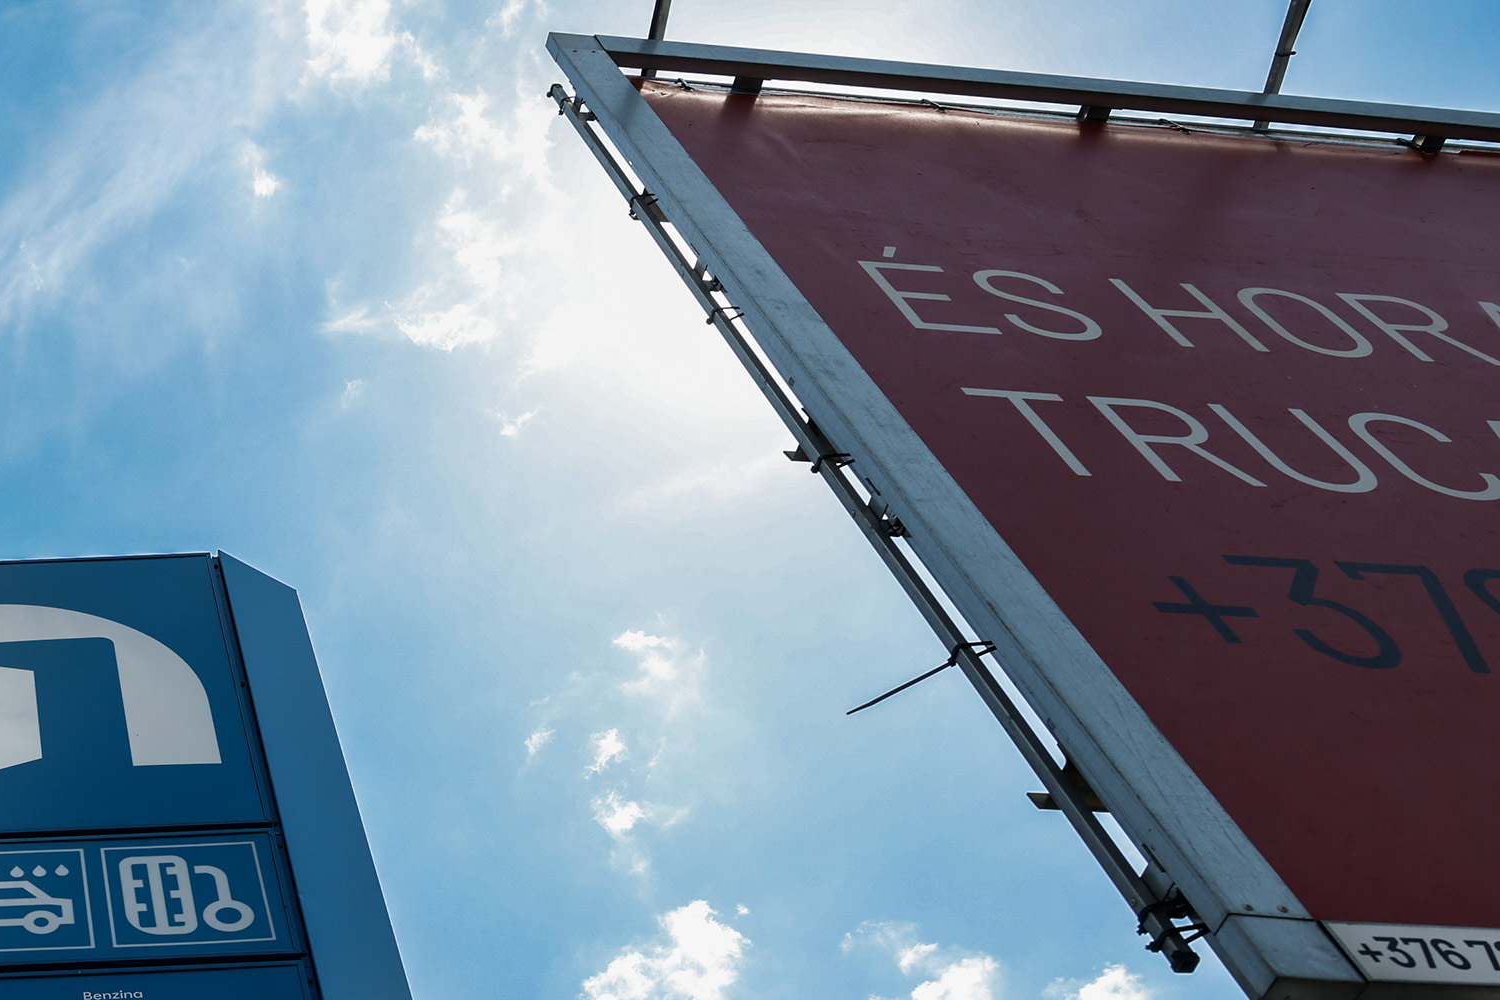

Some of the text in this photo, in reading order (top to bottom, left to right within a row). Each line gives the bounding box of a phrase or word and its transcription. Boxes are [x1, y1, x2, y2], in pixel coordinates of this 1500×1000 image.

[1108, 278, 1500, 366] HOR
[960, 387, 1500, 501] TRUC
[83, 990, 143, 1000] Benzina
